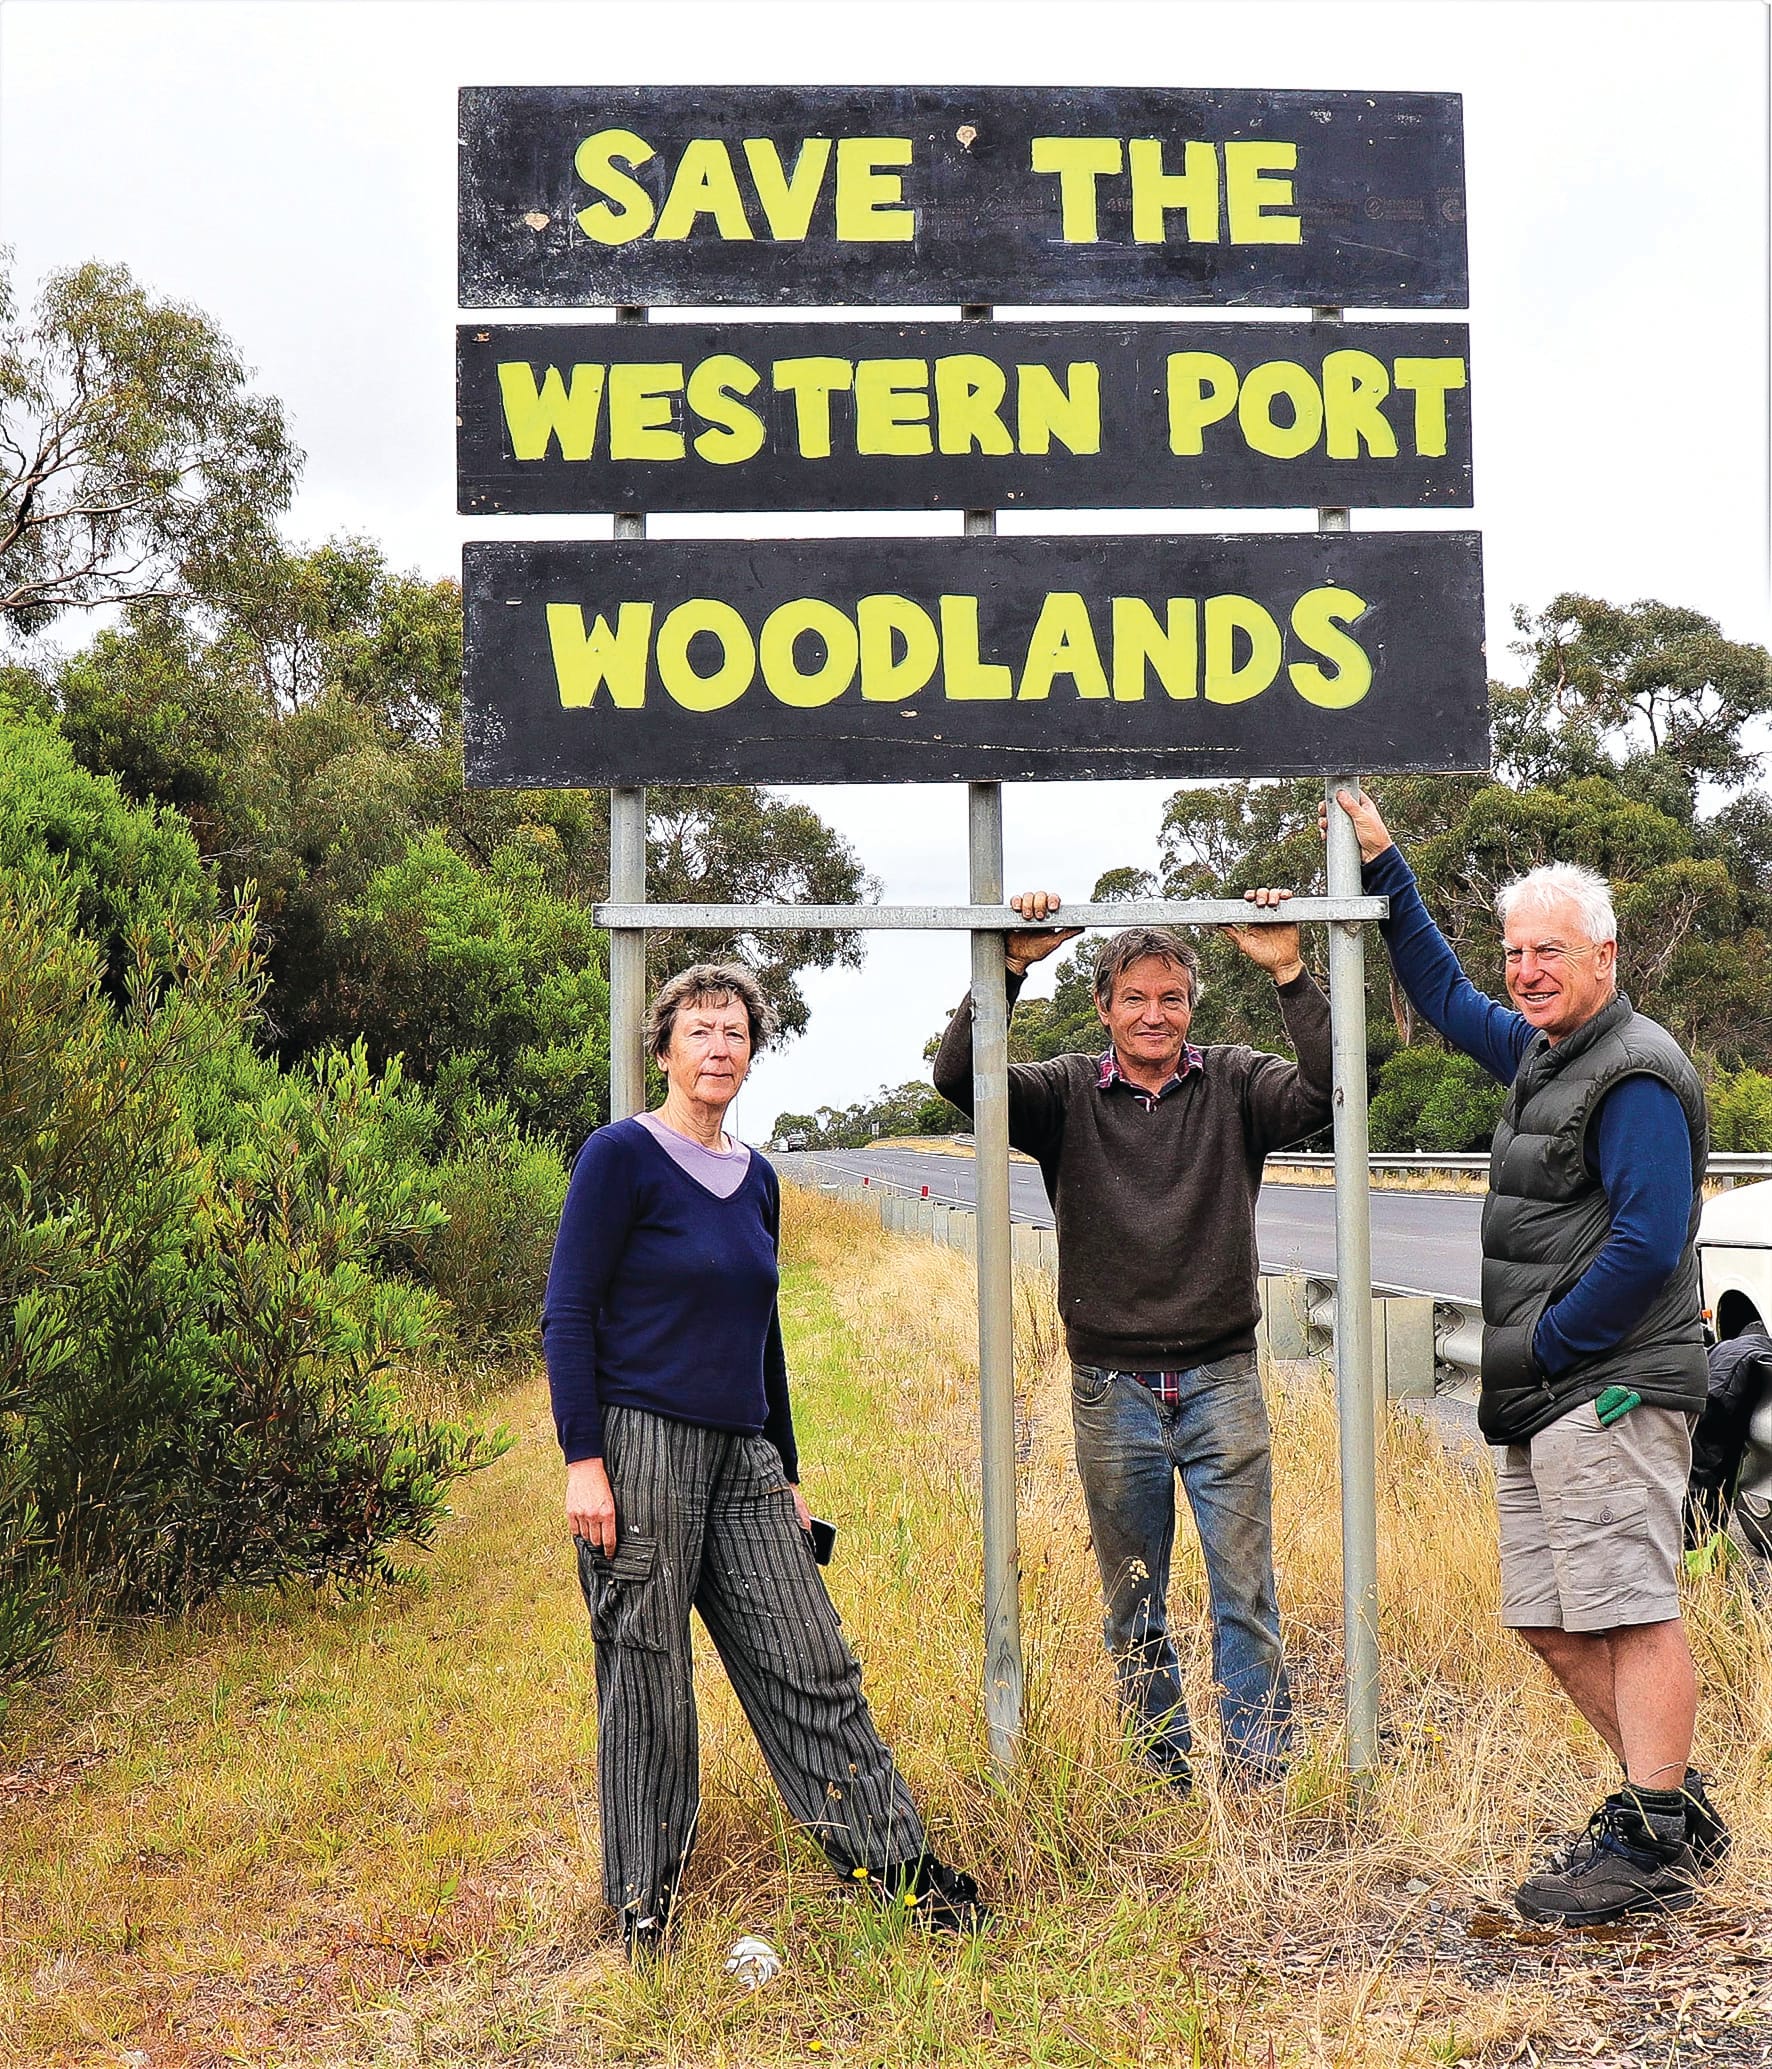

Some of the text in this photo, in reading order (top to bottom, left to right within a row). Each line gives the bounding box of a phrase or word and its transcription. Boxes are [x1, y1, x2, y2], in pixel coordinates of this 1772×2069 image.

[576, 130, 1302, 246] SAVE THE
[499, 350, 1467, 463] WESTERN PORT
[547, 588, 1373, 710] WOODLANDS
